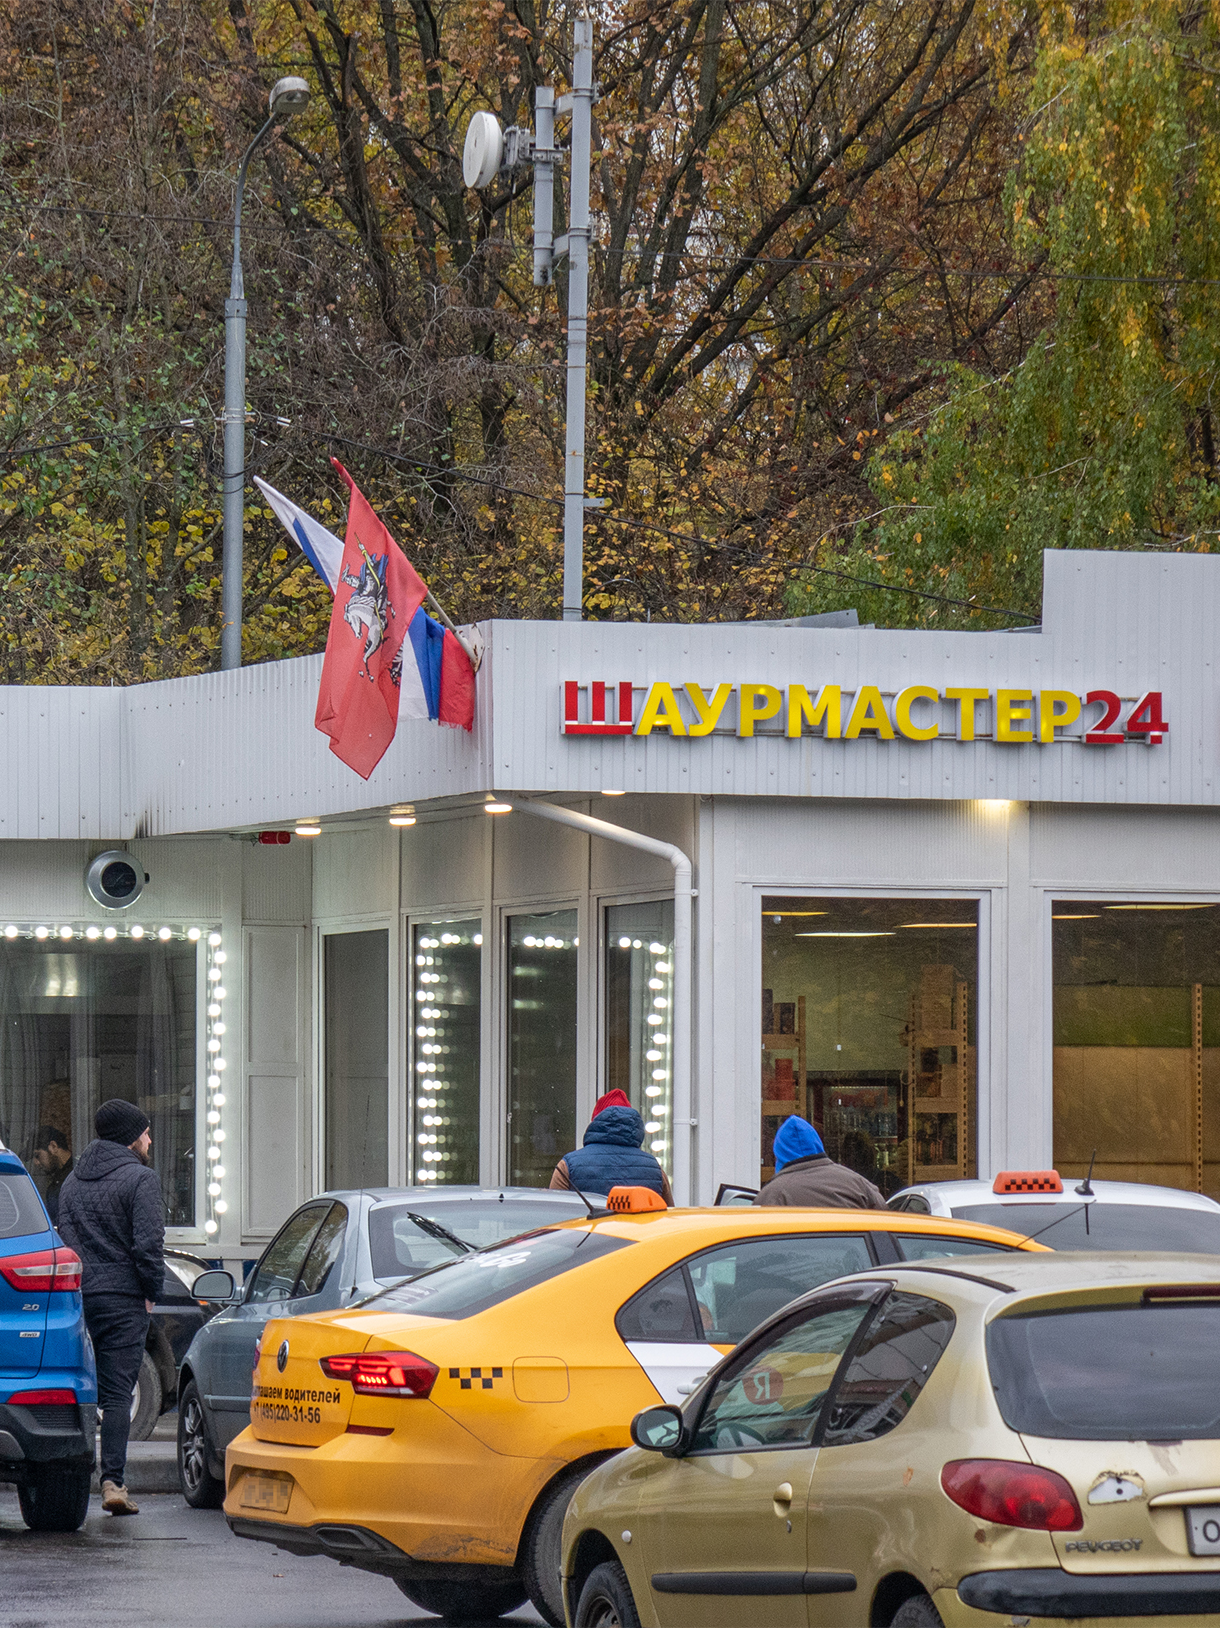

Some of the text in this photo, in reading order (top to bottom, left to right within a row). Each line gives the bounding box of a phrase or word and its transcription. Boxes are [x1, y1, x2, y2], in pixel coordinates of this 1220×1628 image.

[560, 681, 1169, 744] ШАУРМАСТЕР24
[284, 1387, 341, 1404] водителей
[1065, 1538, 1143, 1553] PEUGEOT
